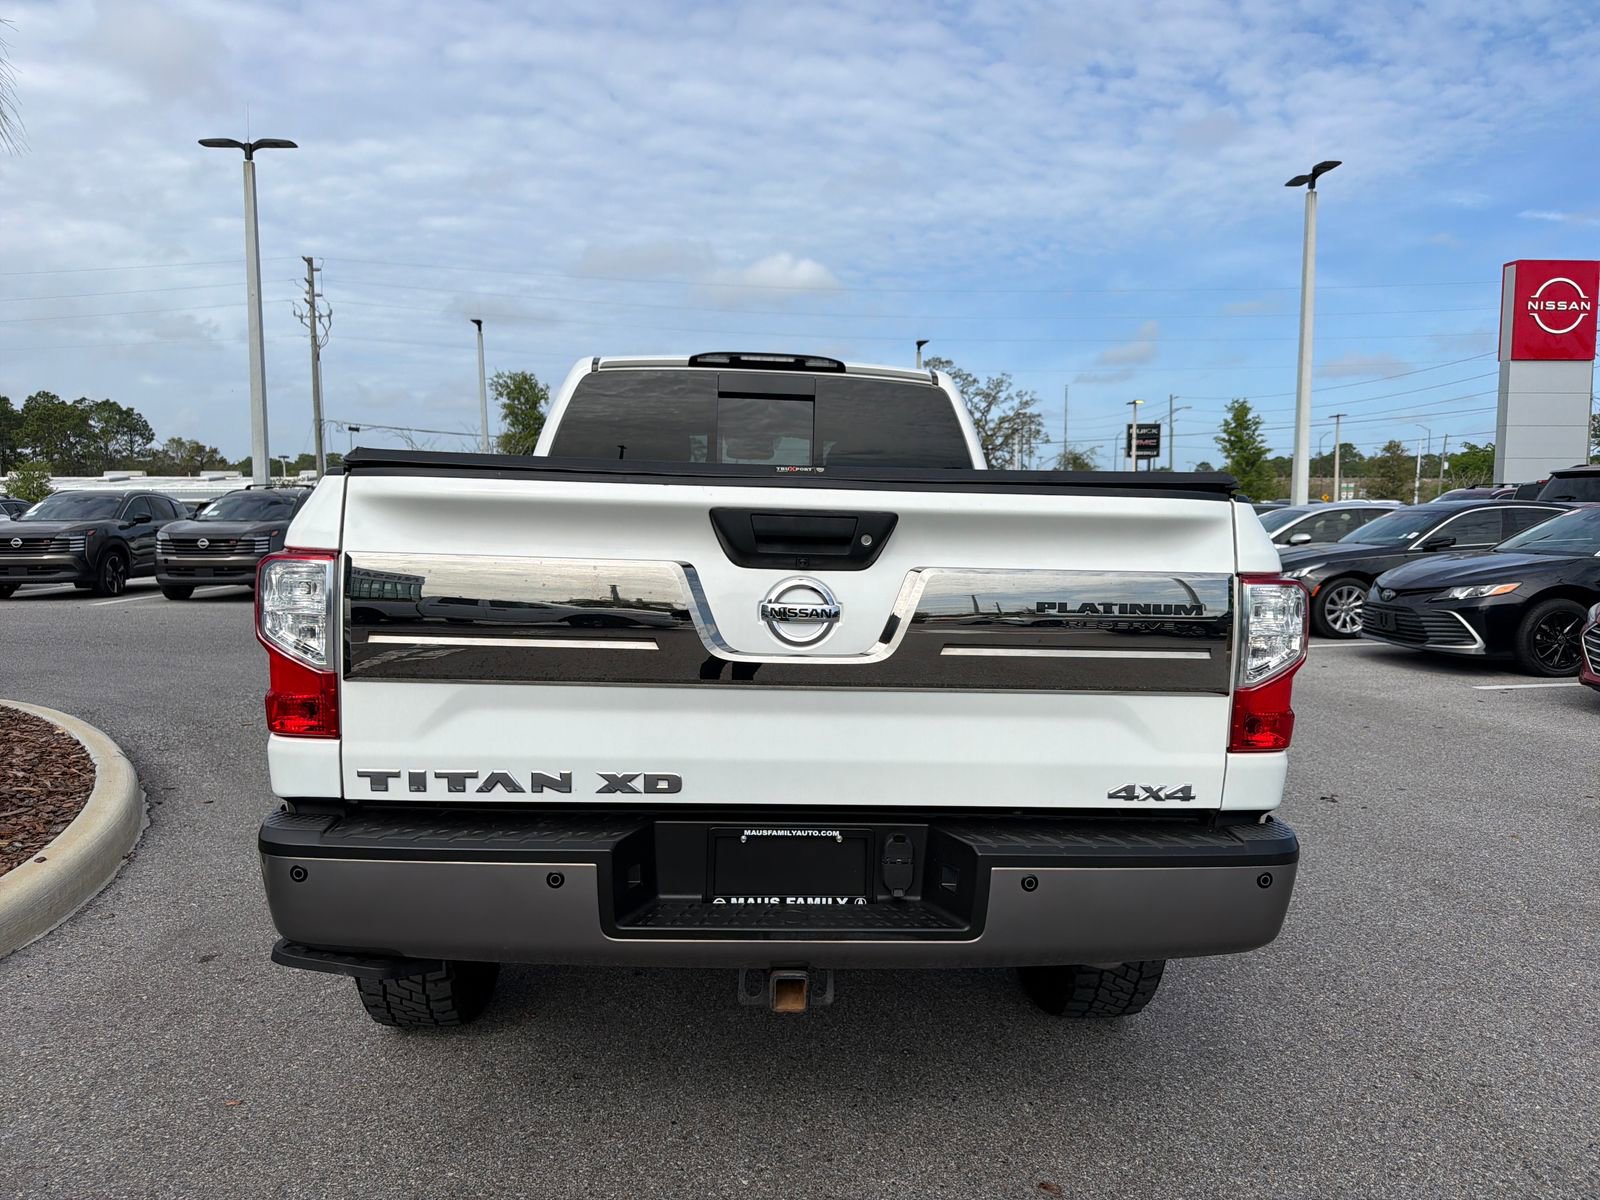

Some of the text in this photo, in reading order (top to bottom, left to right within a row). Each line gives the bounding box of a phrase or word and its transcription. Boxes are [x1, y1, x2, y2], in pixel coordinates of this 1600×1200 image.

[1527, 301, 1591, 311] NISSAN
[769, 607, 832, 619] NISSAN
[1036, 601, 1204, 616] PLATINUM
[1064, 620, 1175, 630] RESERVE
[356, 768, 683, 794] TITAN XD
[743, 829, 840, 837] MAUSFAMILYAUTO.COM
